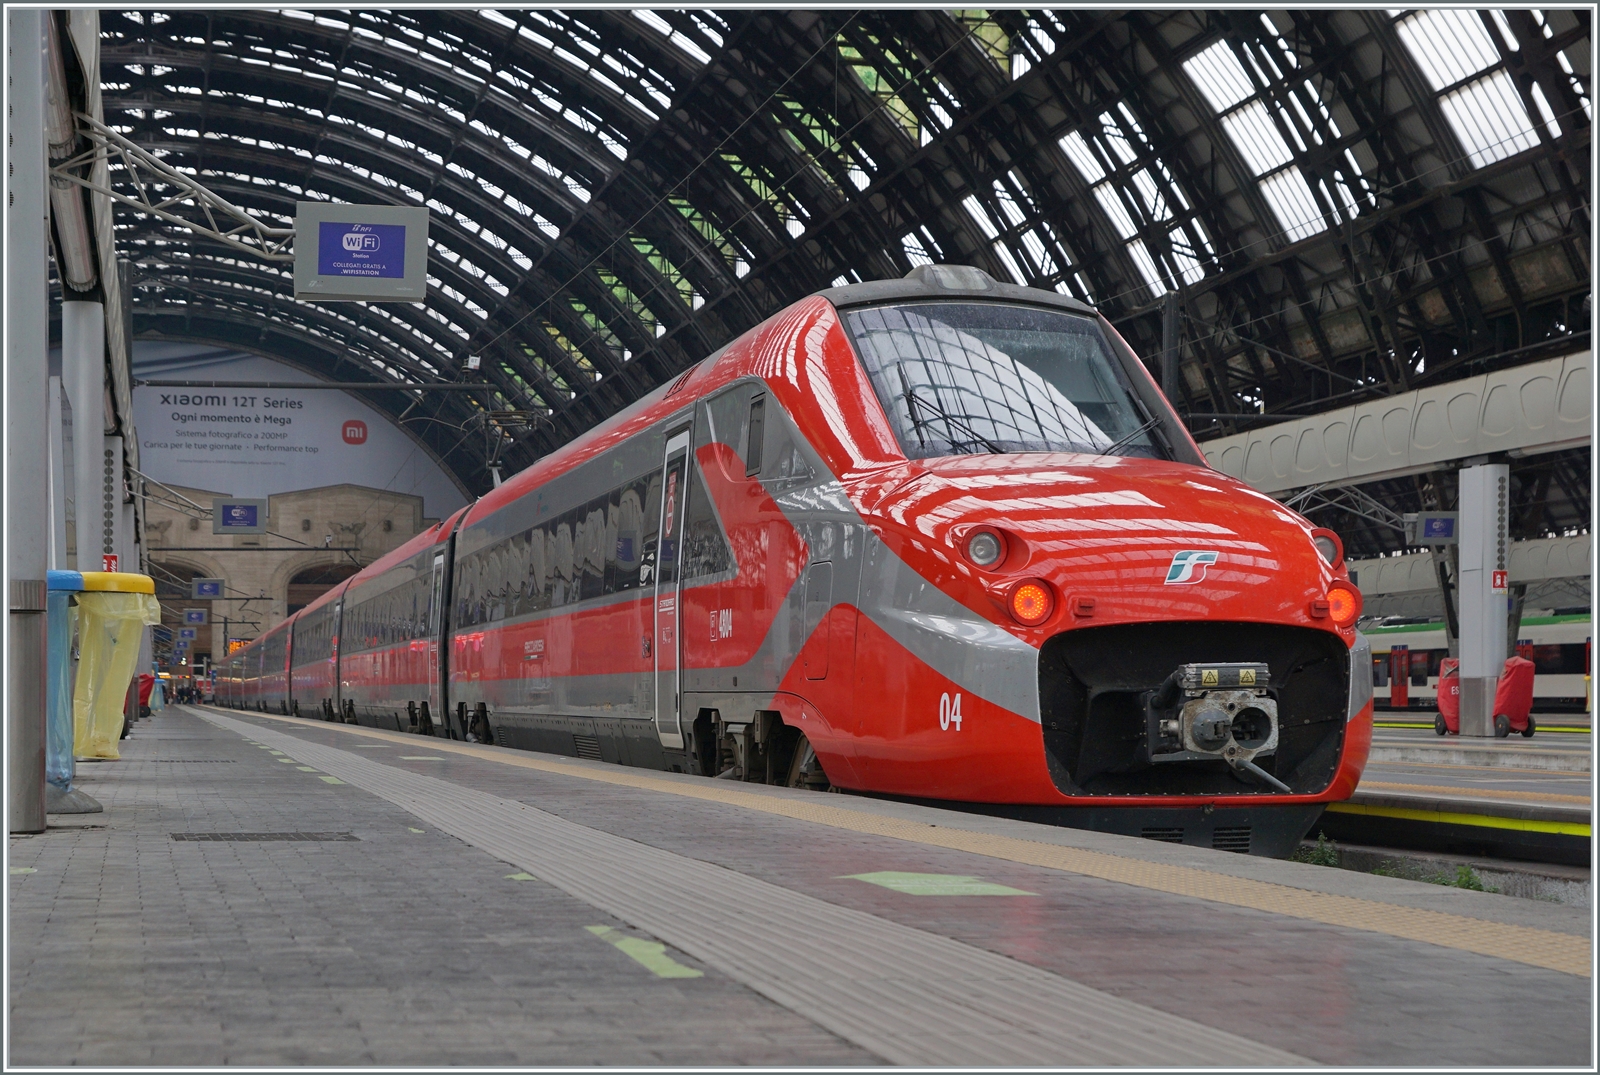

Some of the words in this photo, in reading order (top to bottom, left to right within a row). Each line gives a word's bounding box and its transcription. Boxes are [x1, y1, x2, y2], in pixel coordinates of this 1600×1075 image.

[345, 236, 376, 249] WiFi
[332, 261, 361, 269] COLLEGATI
[232, 396, 258, 408] 12T
[263, 397, 304, 409] Series
[171, 412, 198, 424] Ogni
[200, 413, 252, 424] momento
[254, 414, 261, 424] è
[263, 415, 293, 427] Mega
[175, 429, 207, 438] Sistema
[208, 430, 253, 440] fotografico
[260, 431, 288, 440] 200MP
[143, 440, 169, 449] Carica
[170, 442, 183, 450] per
[185, 441, 193, 449] le
[194, 442, 208, 450] tue
[208, 443, 243, 452] giornate
[253, 444, 304, 453] Performance
[305, 445, 319, 454] top
[939, 691, 963, 732] 04
